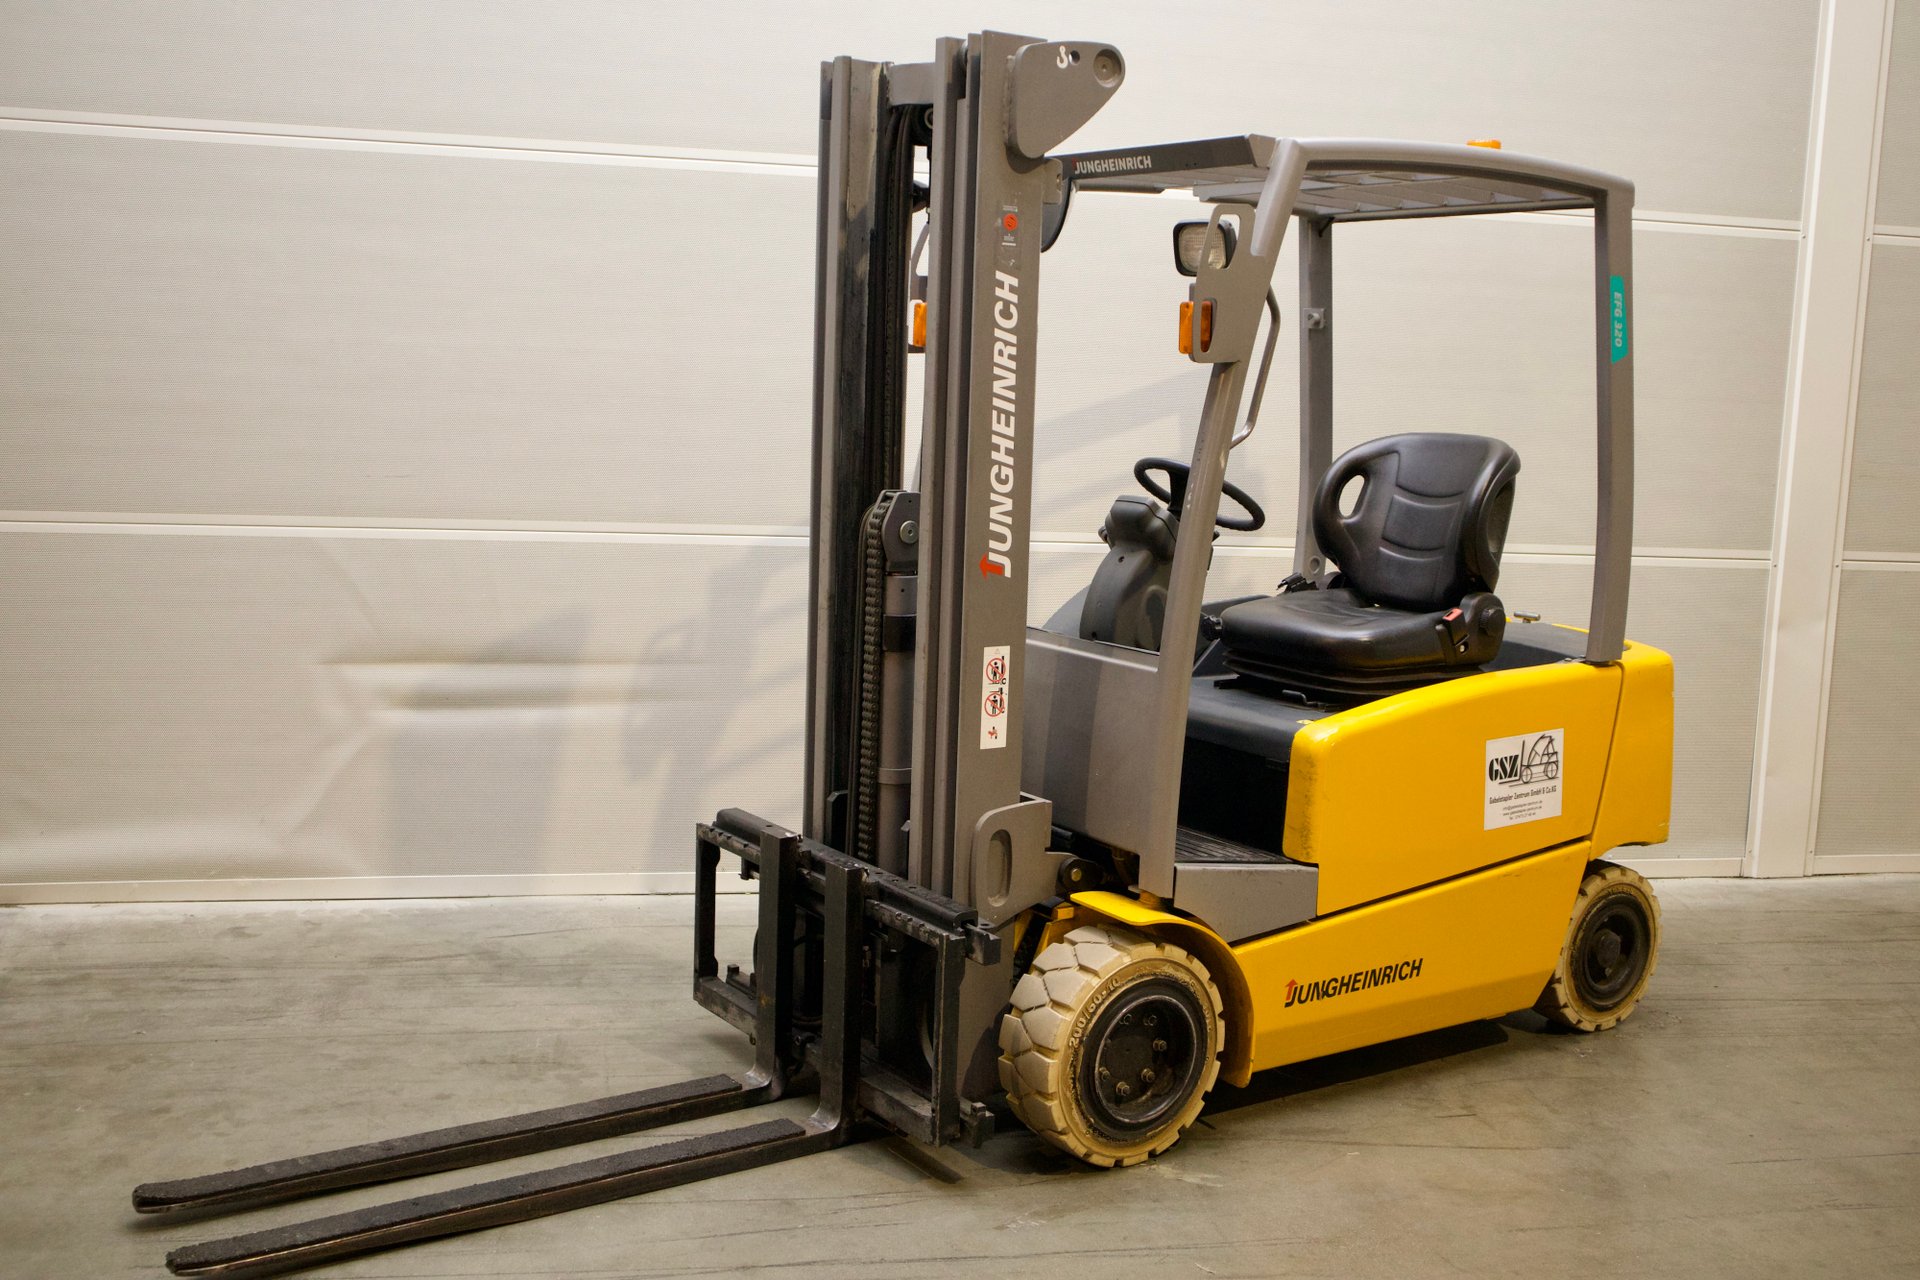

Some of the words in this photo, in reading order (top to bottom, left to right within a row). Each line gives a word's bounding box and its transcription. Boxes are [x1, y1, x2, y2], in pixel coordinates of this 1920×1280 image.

[1074, 155, 1152, 175] JUNGHEINRICH
[1613, 291, 1622, 318] EFG
[1614, 319, 1623, 347] 320
[988, 270, 1018, 578] JUNGHEINRICH
[1488, 754, 1519, 781] GSZ
[1284, 958, 1424, 1008] JUNGHEINRICH
